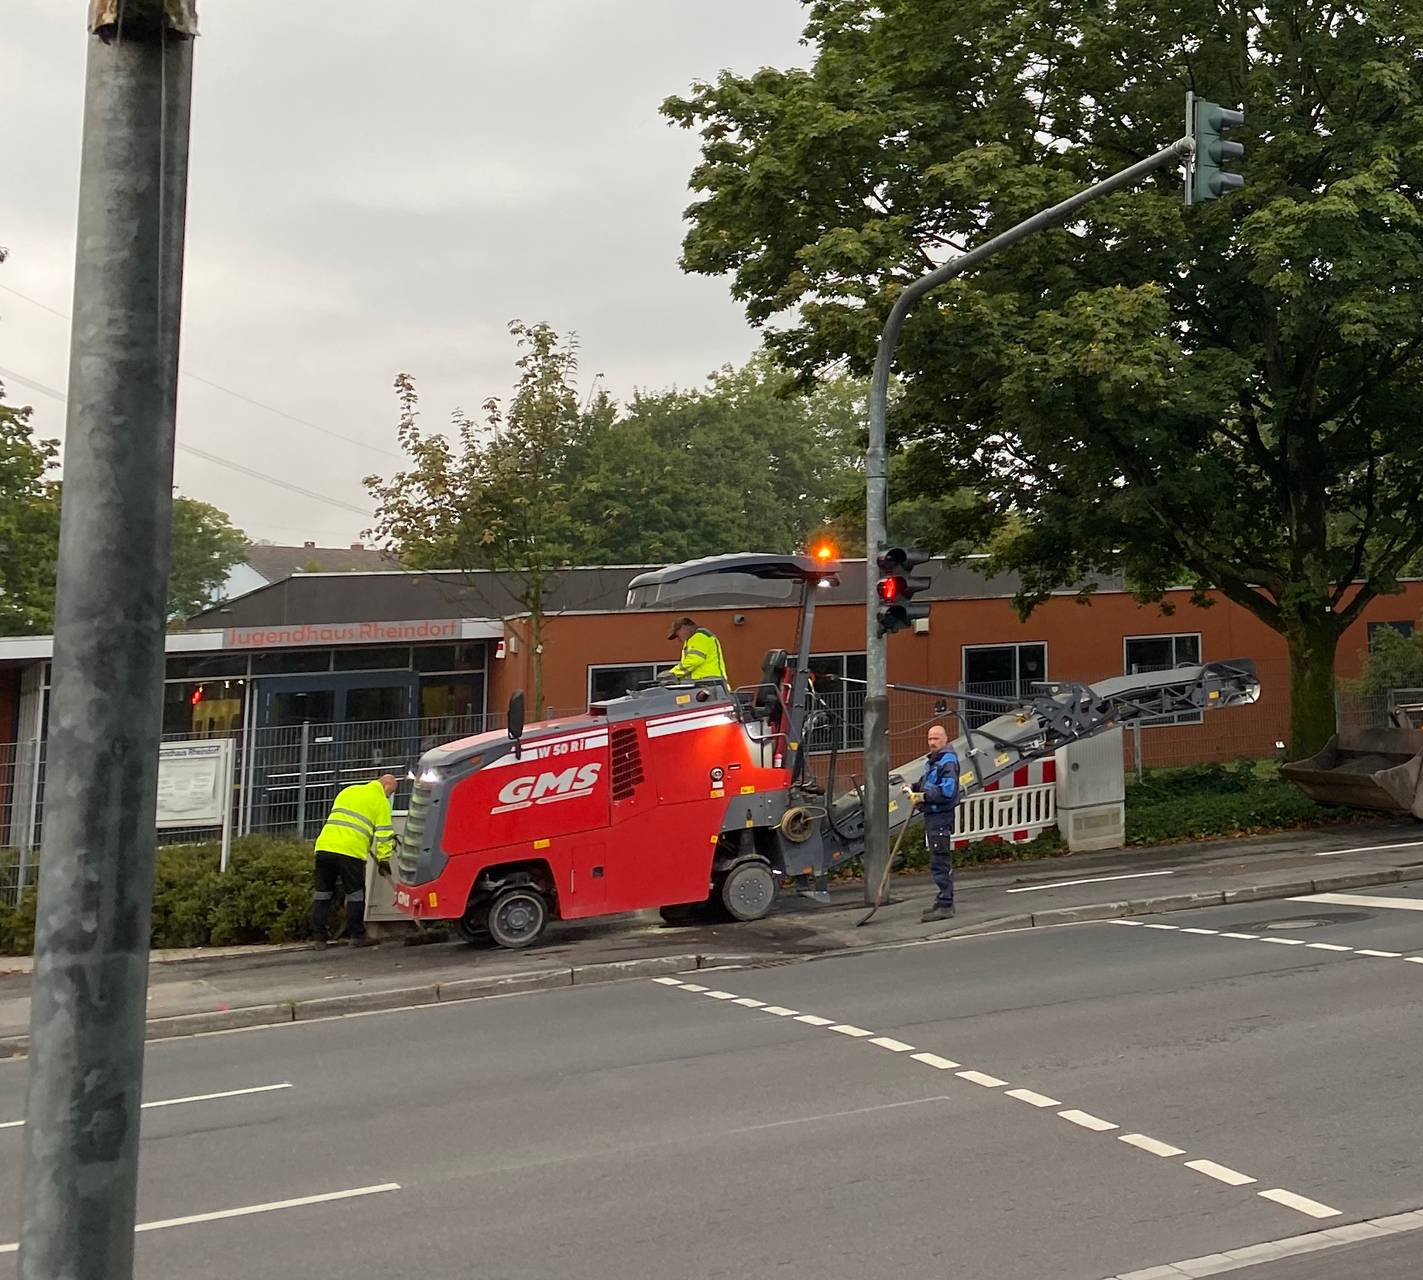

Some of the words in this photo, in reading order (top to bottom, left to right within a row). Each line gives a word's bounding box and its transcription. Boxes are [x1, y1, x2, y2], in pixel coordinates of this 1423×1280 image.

[231, 624, 354, 646] Jugendhaus
[359, 621, 458, 640] Rheindorf
[538, 746, 552, 759] W
[552, 743, 568, 756] 50
[498, 762, 602, 804] GMS
